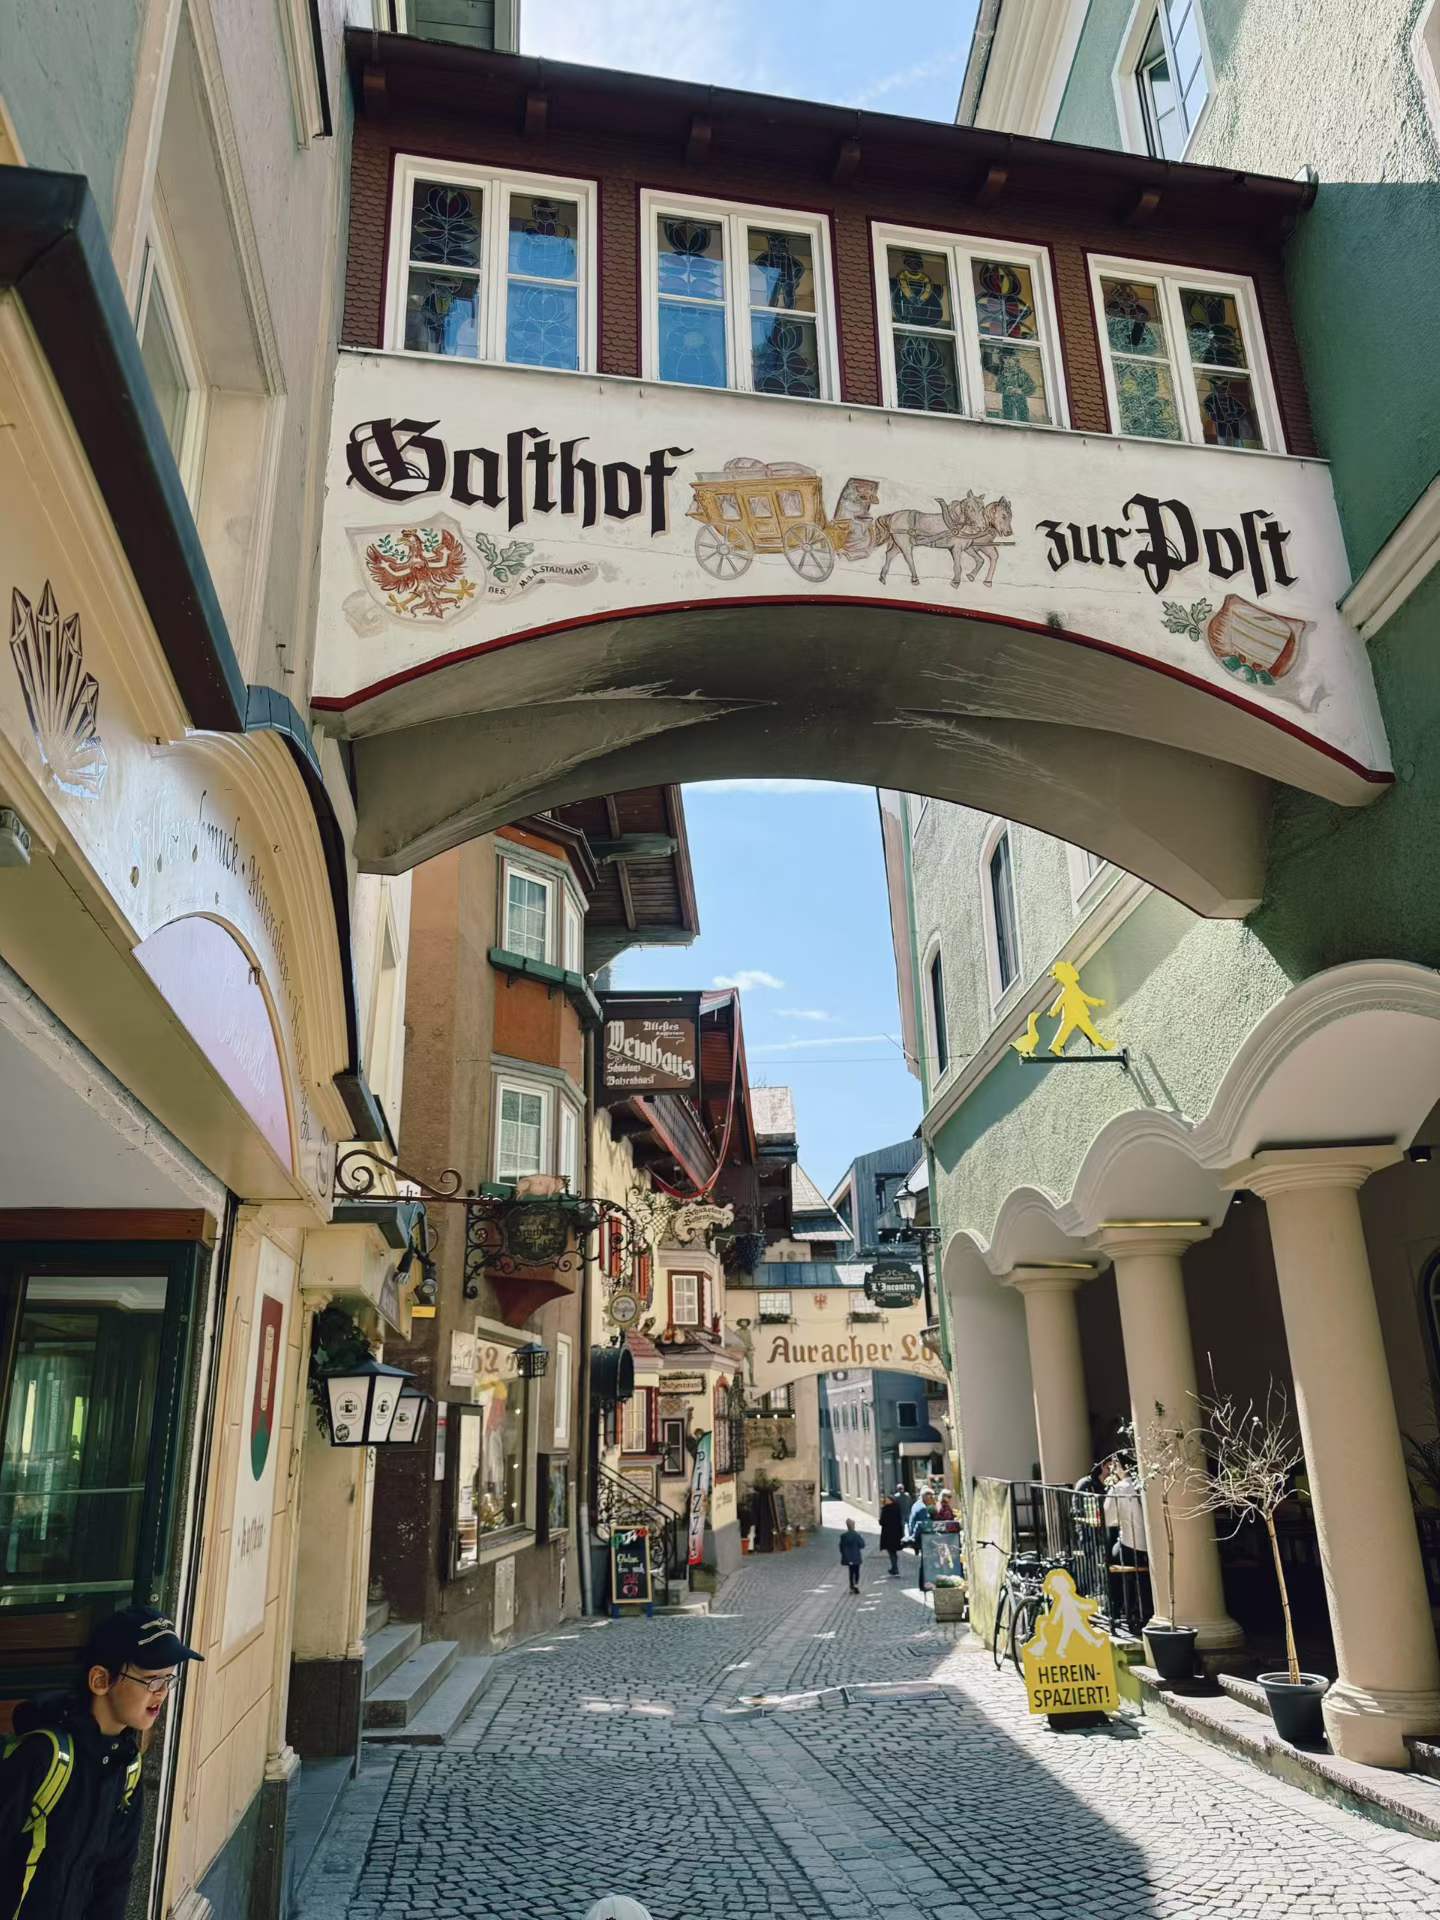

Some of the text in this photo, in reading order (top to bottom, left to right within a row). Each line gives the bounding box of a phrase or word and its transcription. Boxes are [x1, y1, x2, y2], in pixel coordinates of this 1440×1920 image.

[346, 418, 693, 537] Gasthof
[1036, 493, 1299, 598] zur Post
[607, 1020, 695, 1081] Weinhaus
[767, 1335, 894, 1365] Auracher
[1038, 1663, 1101, 1684] HEREIN-
[1033, 1686, 1111, 1708] SPAZIERT!
